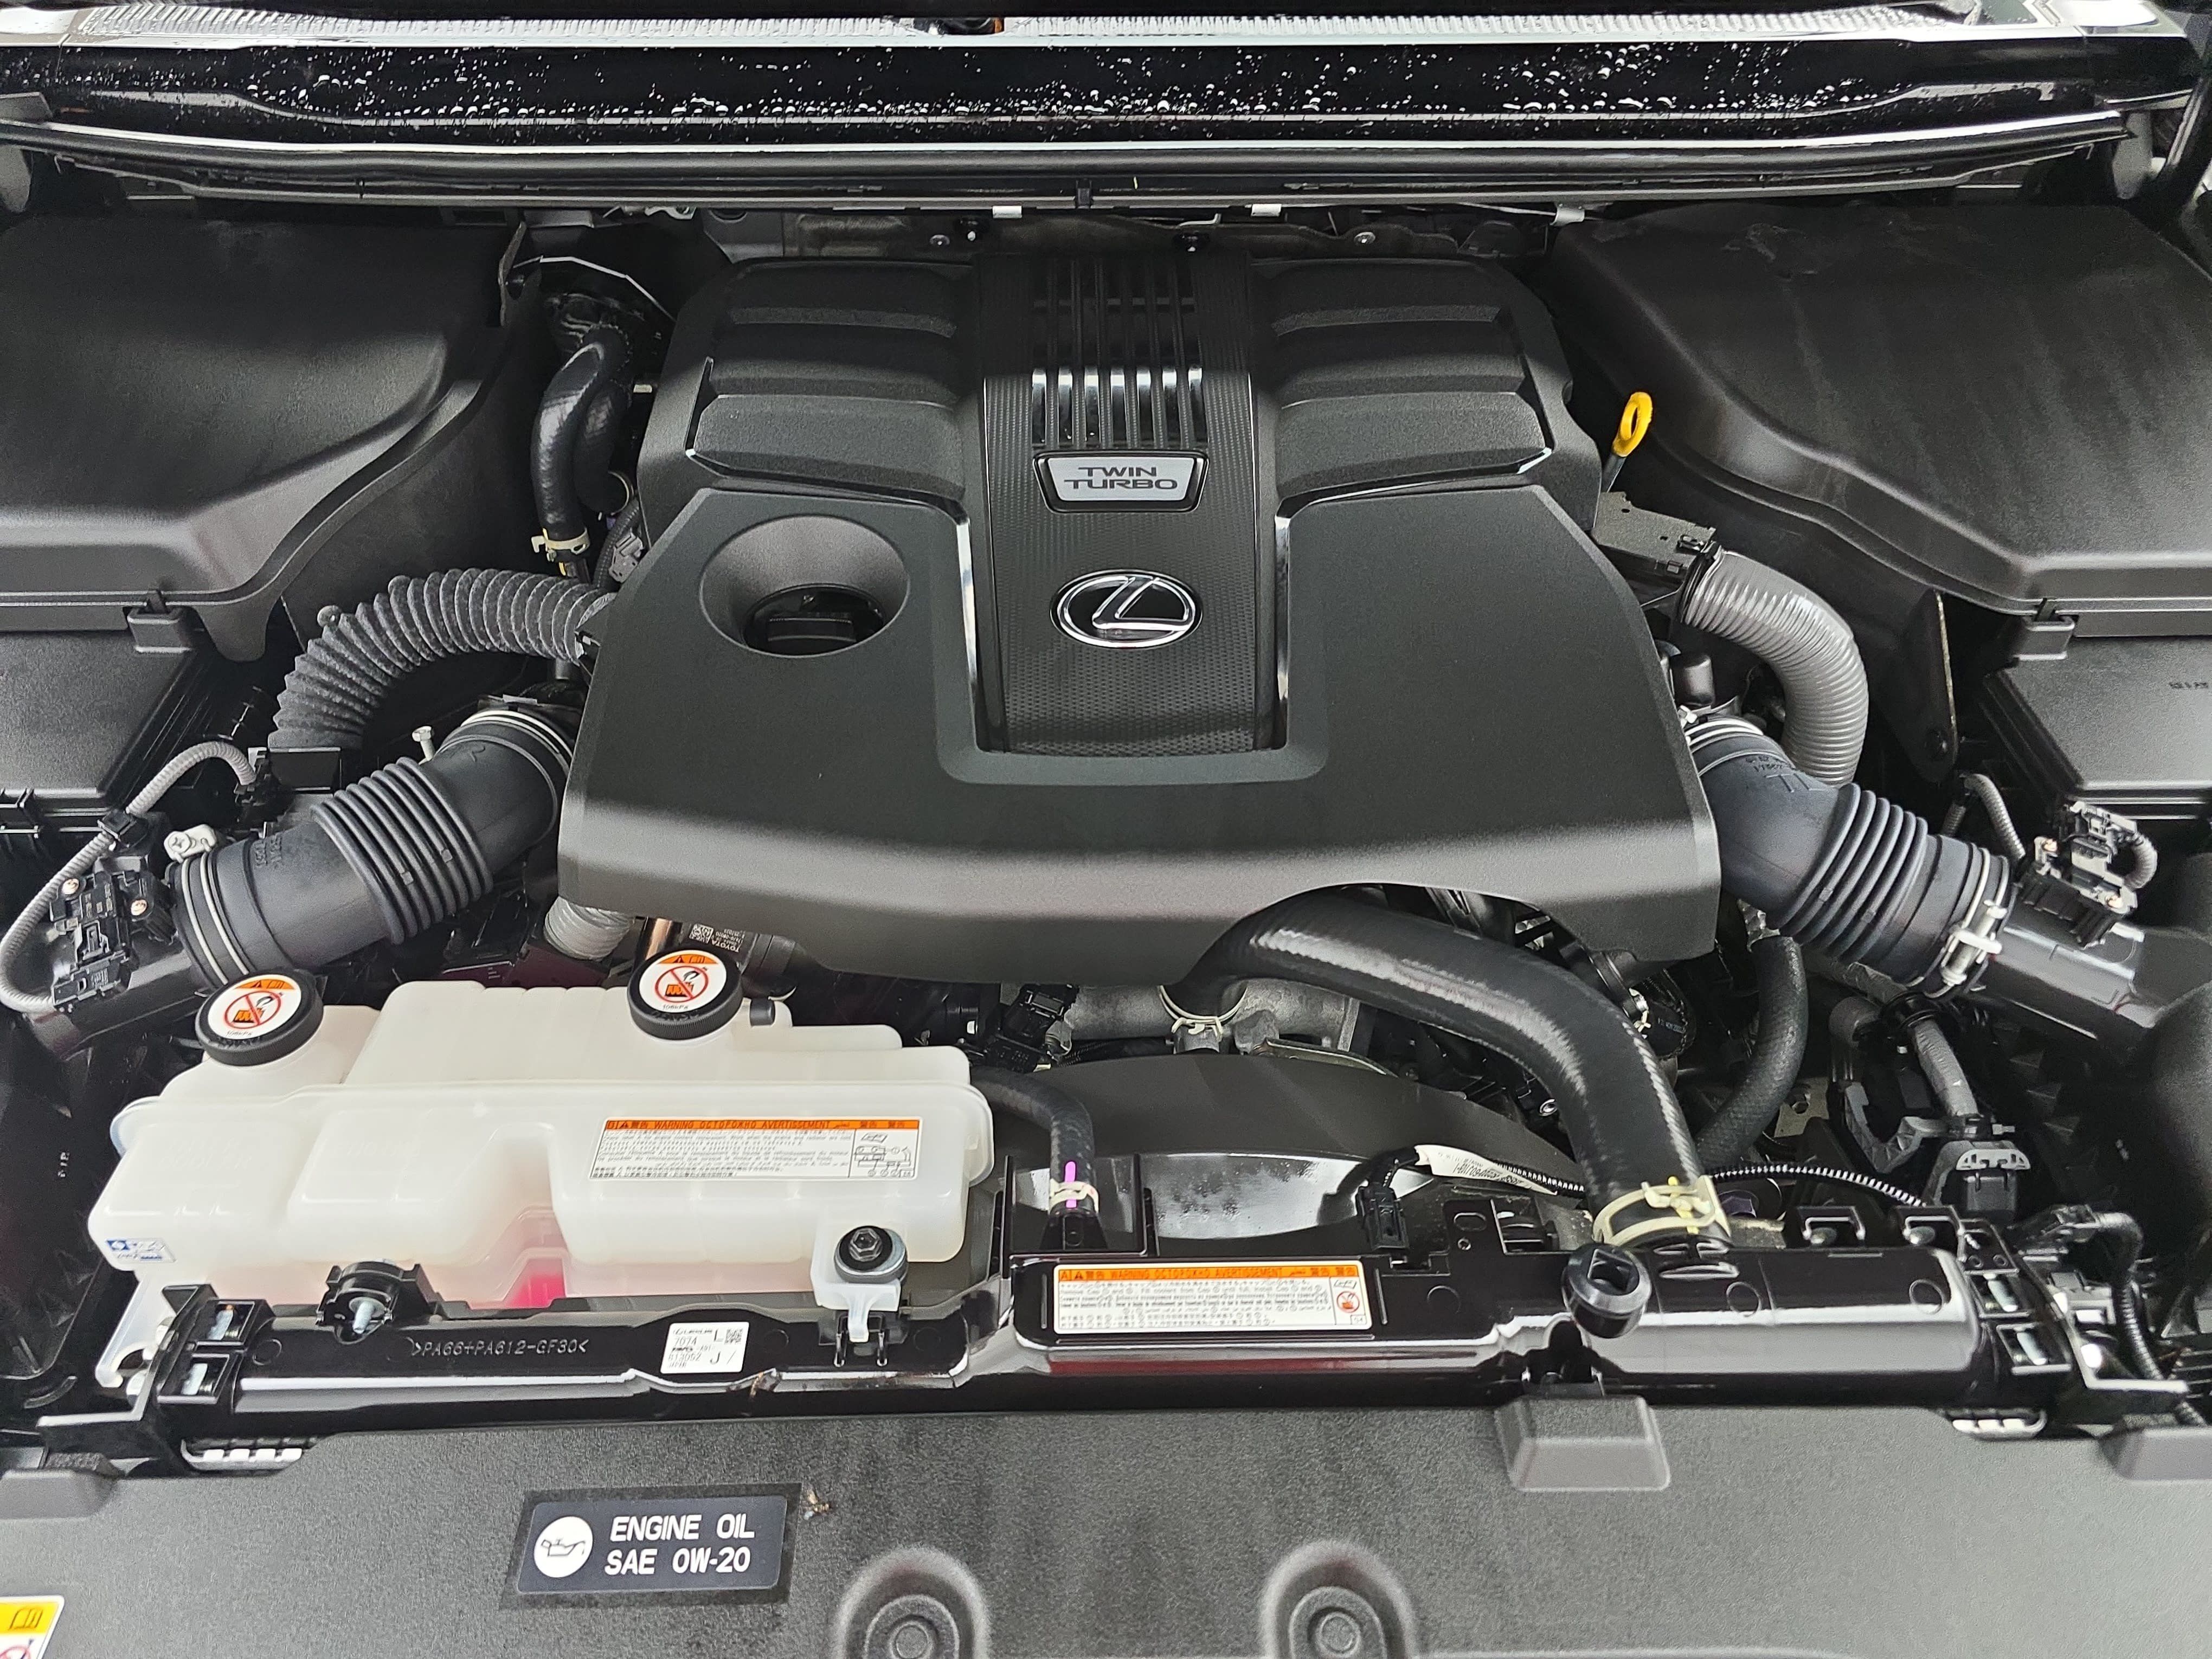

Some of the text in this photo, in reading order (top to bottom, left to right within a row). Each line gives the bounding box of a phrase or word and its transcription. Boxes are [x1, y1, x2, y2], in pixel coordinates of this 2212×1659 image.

[1078, 466, 1157, 477] TWIN
[1064, 479, 1178, 490] TURBO
[711, 938, 741, 953] TOYOTA
[654, 1121, 694, 1129] WARNING
[761, 1121, 830, 1129] AVERTISSEMENT
[1111, 1269, 1150, 1278] WARNING
[1215, 1267, 1282, 1277] AVERTISSEMENT
[609, 1513, 755, 1542] ENGINE OIL
[604, 1546, 751, 1576] SAE 0W-20
